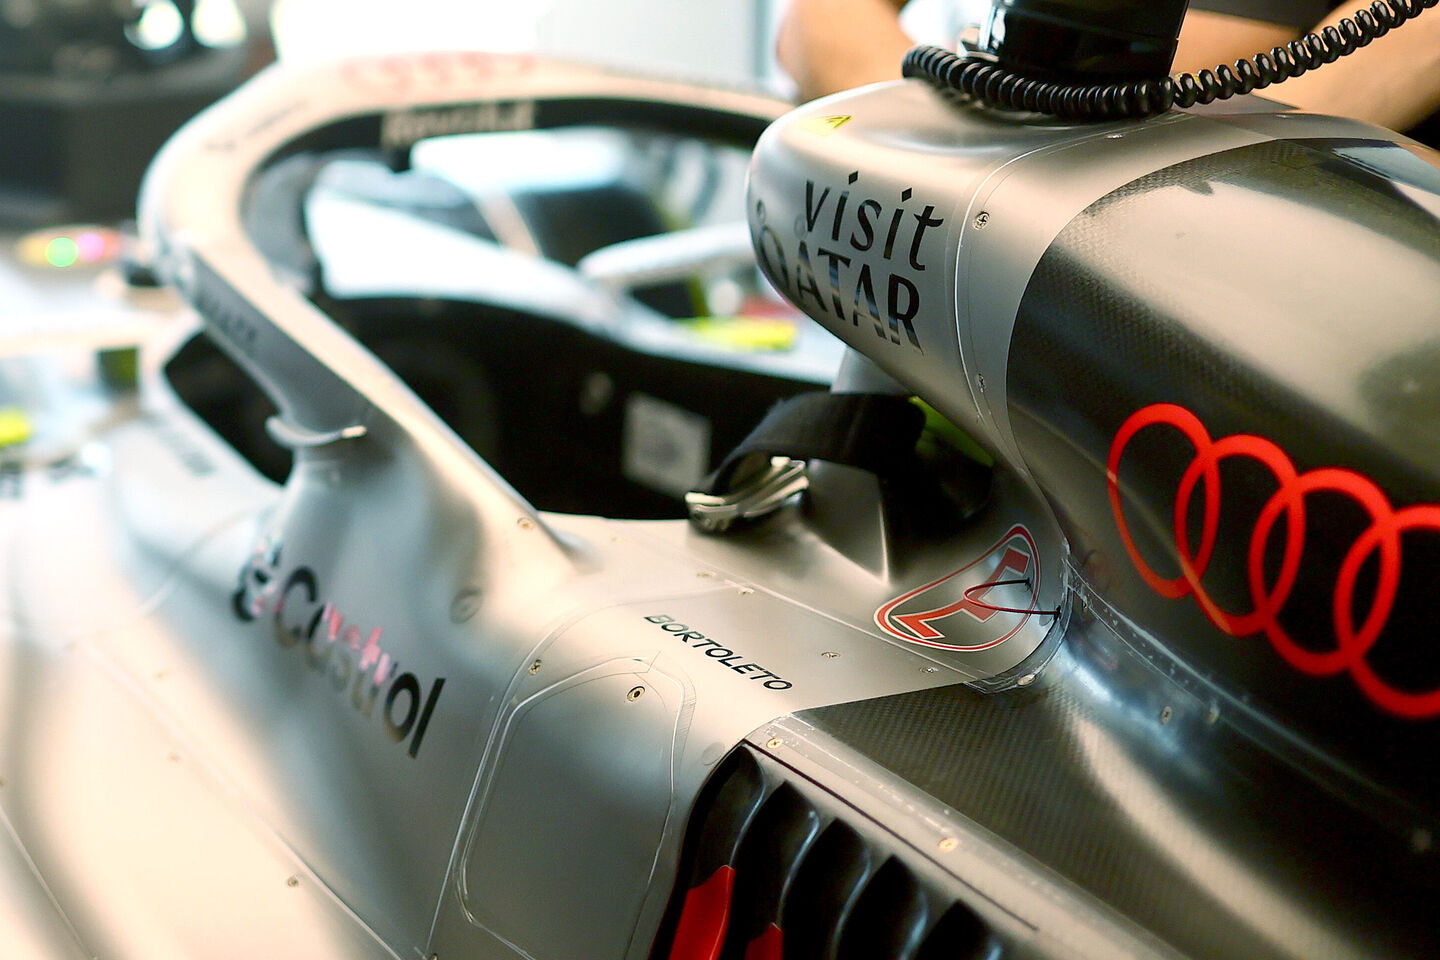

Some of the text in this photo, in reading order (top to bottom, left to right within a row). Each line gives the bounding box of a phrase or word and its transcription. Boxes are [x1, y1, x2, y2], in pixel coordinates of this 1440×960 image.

[805, 170, 945, 272] visit
[758, 224, 926, 357] QATAR
[643, 614, 793, 691] BORTOLETO
